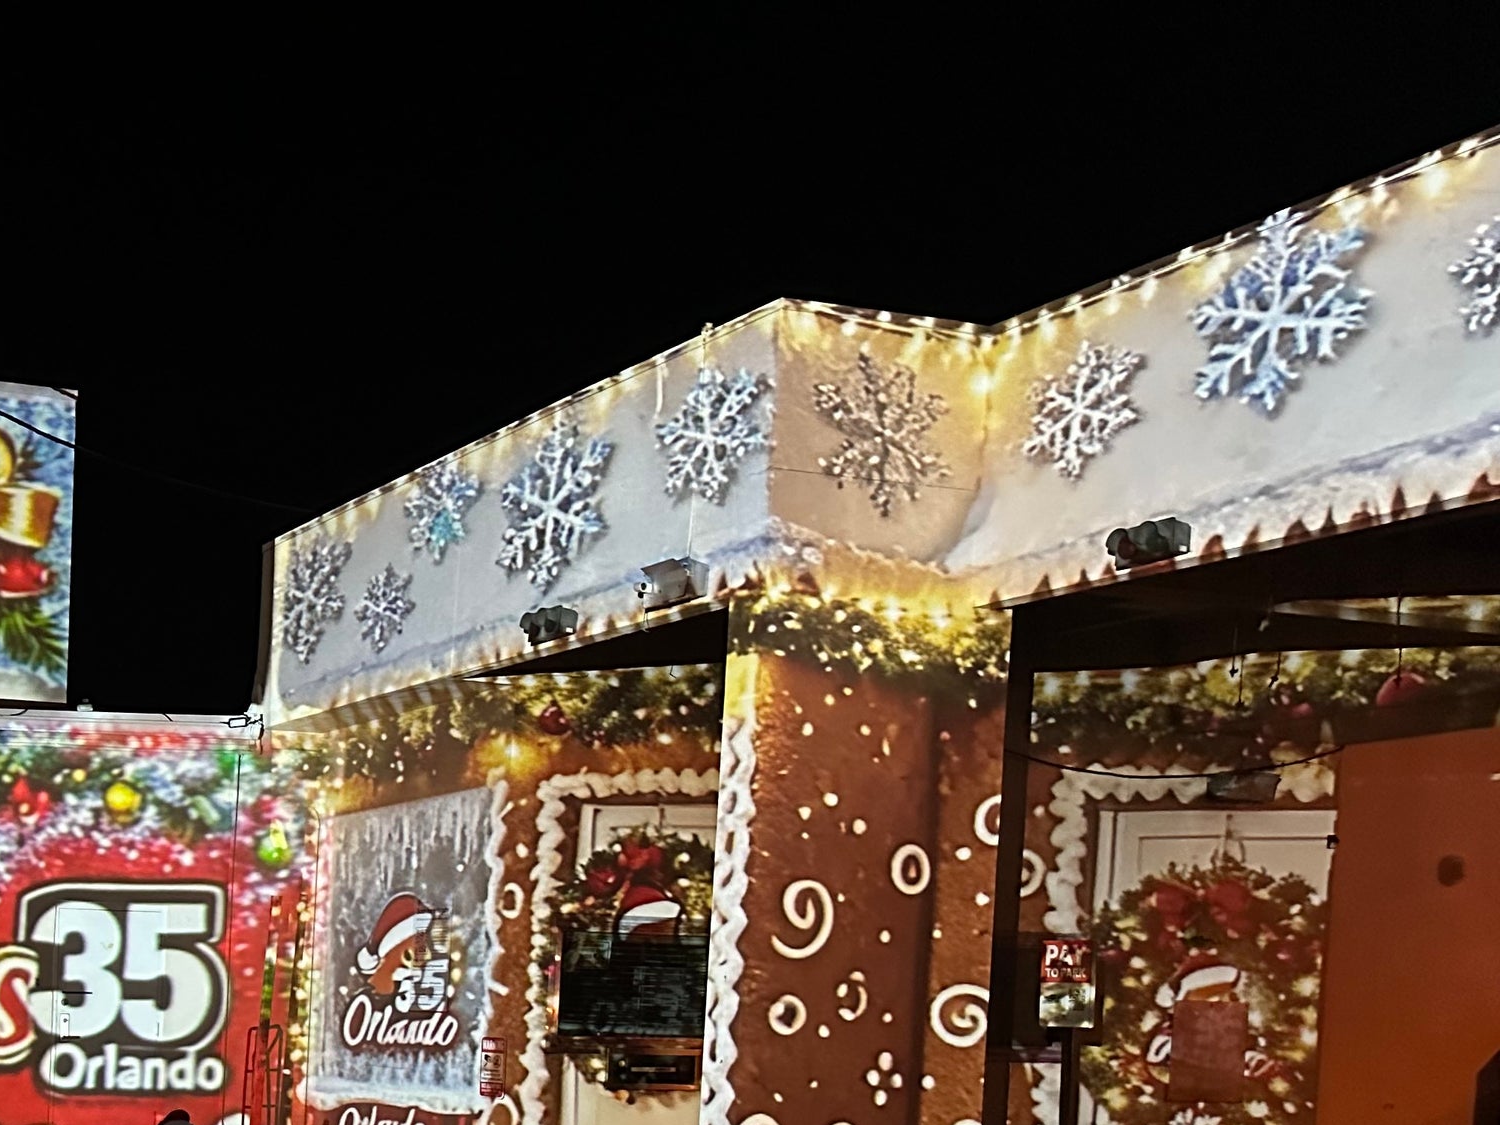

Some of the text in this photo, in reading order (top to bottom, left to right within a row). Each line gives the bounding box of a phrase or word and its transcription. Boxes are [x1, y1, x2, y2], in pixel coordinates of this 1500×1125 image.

[28, 900, 213, 1042] 35
[1045, 944, 1090, 966] PAY
[1045, 967, 1087, 978] TO PARK
[392, 958, 449, 1014] 35
[343, 994, 458, 1046] Orlando
[40, 1042, 225, 1090] Orlando
